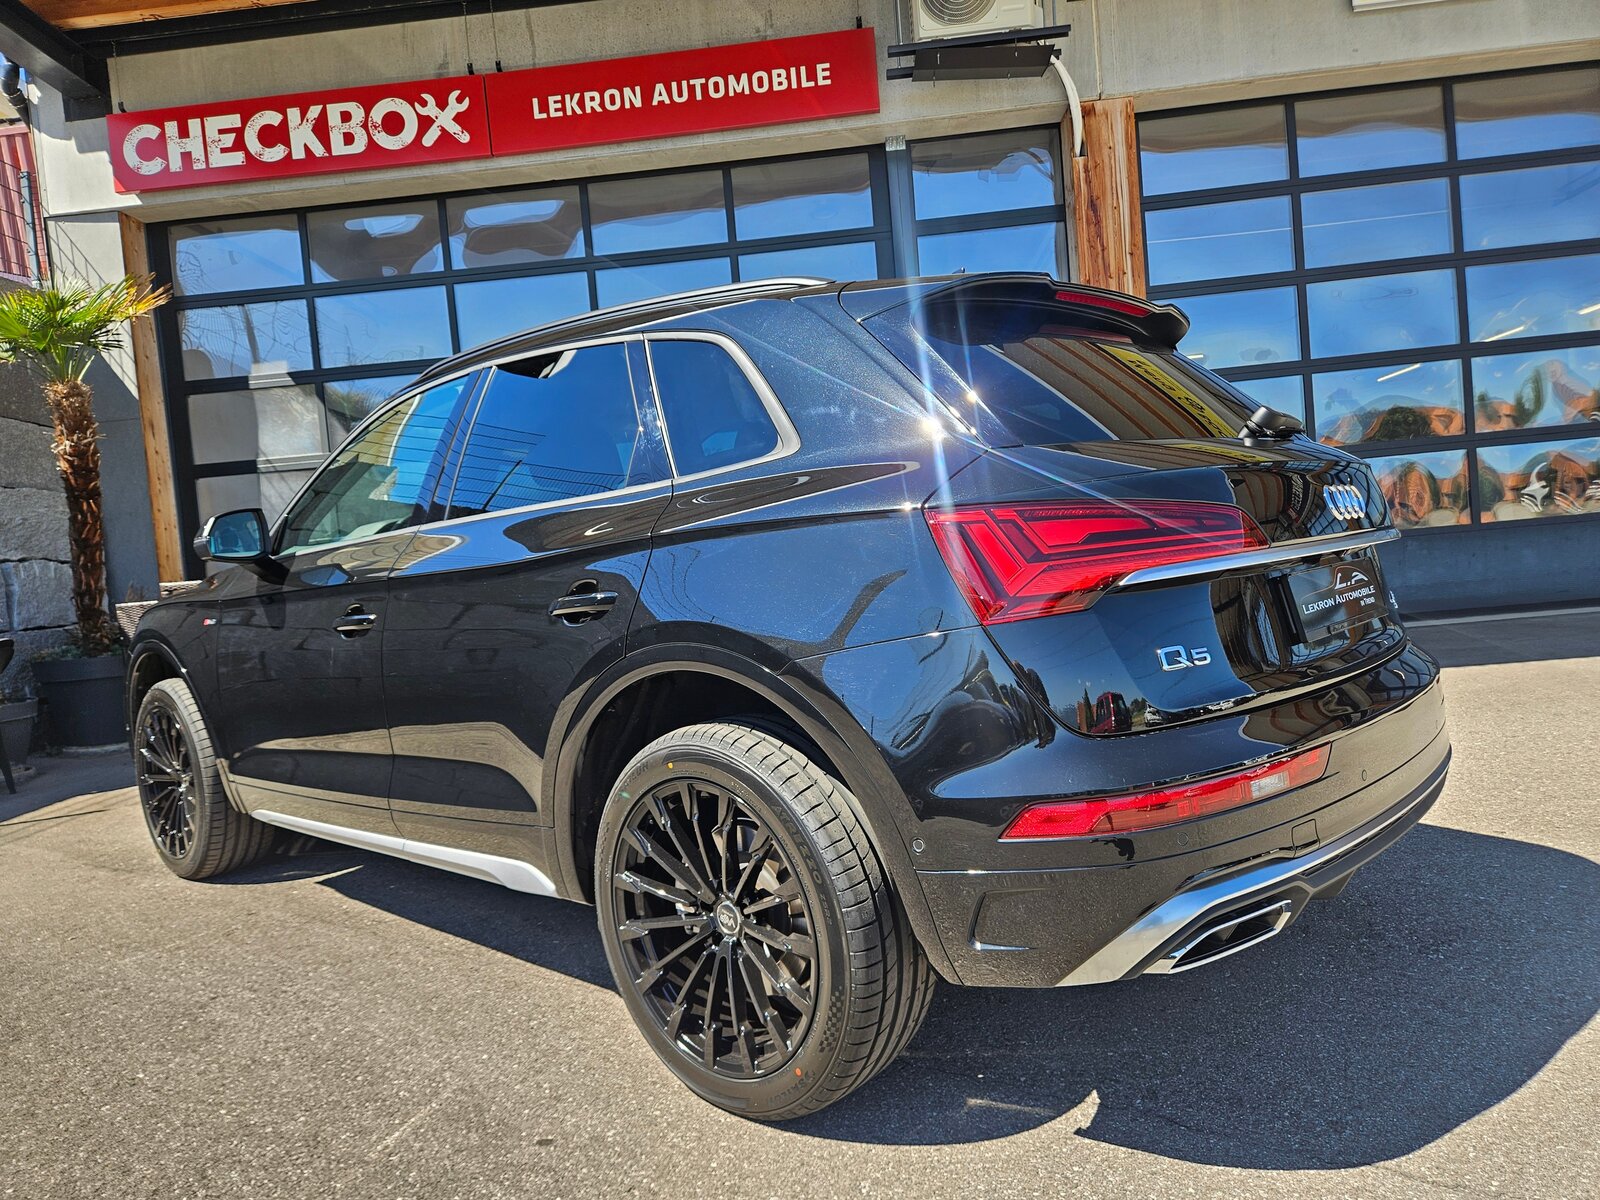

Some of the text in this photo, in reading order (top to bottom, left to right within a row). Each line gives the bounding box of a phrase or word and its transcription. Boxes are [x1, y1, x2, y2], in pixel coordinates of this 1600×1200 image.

[532, 63, 832, 119] LEKRON AUTOMOBILE
[123, 89, 470, 175] CHECKBOX
[1302, 598, 1335, 615] LEKRON
[1335, 585, 1376, 604] AUTOMOBILE
[1156, 645, 1212, 671] Q5
